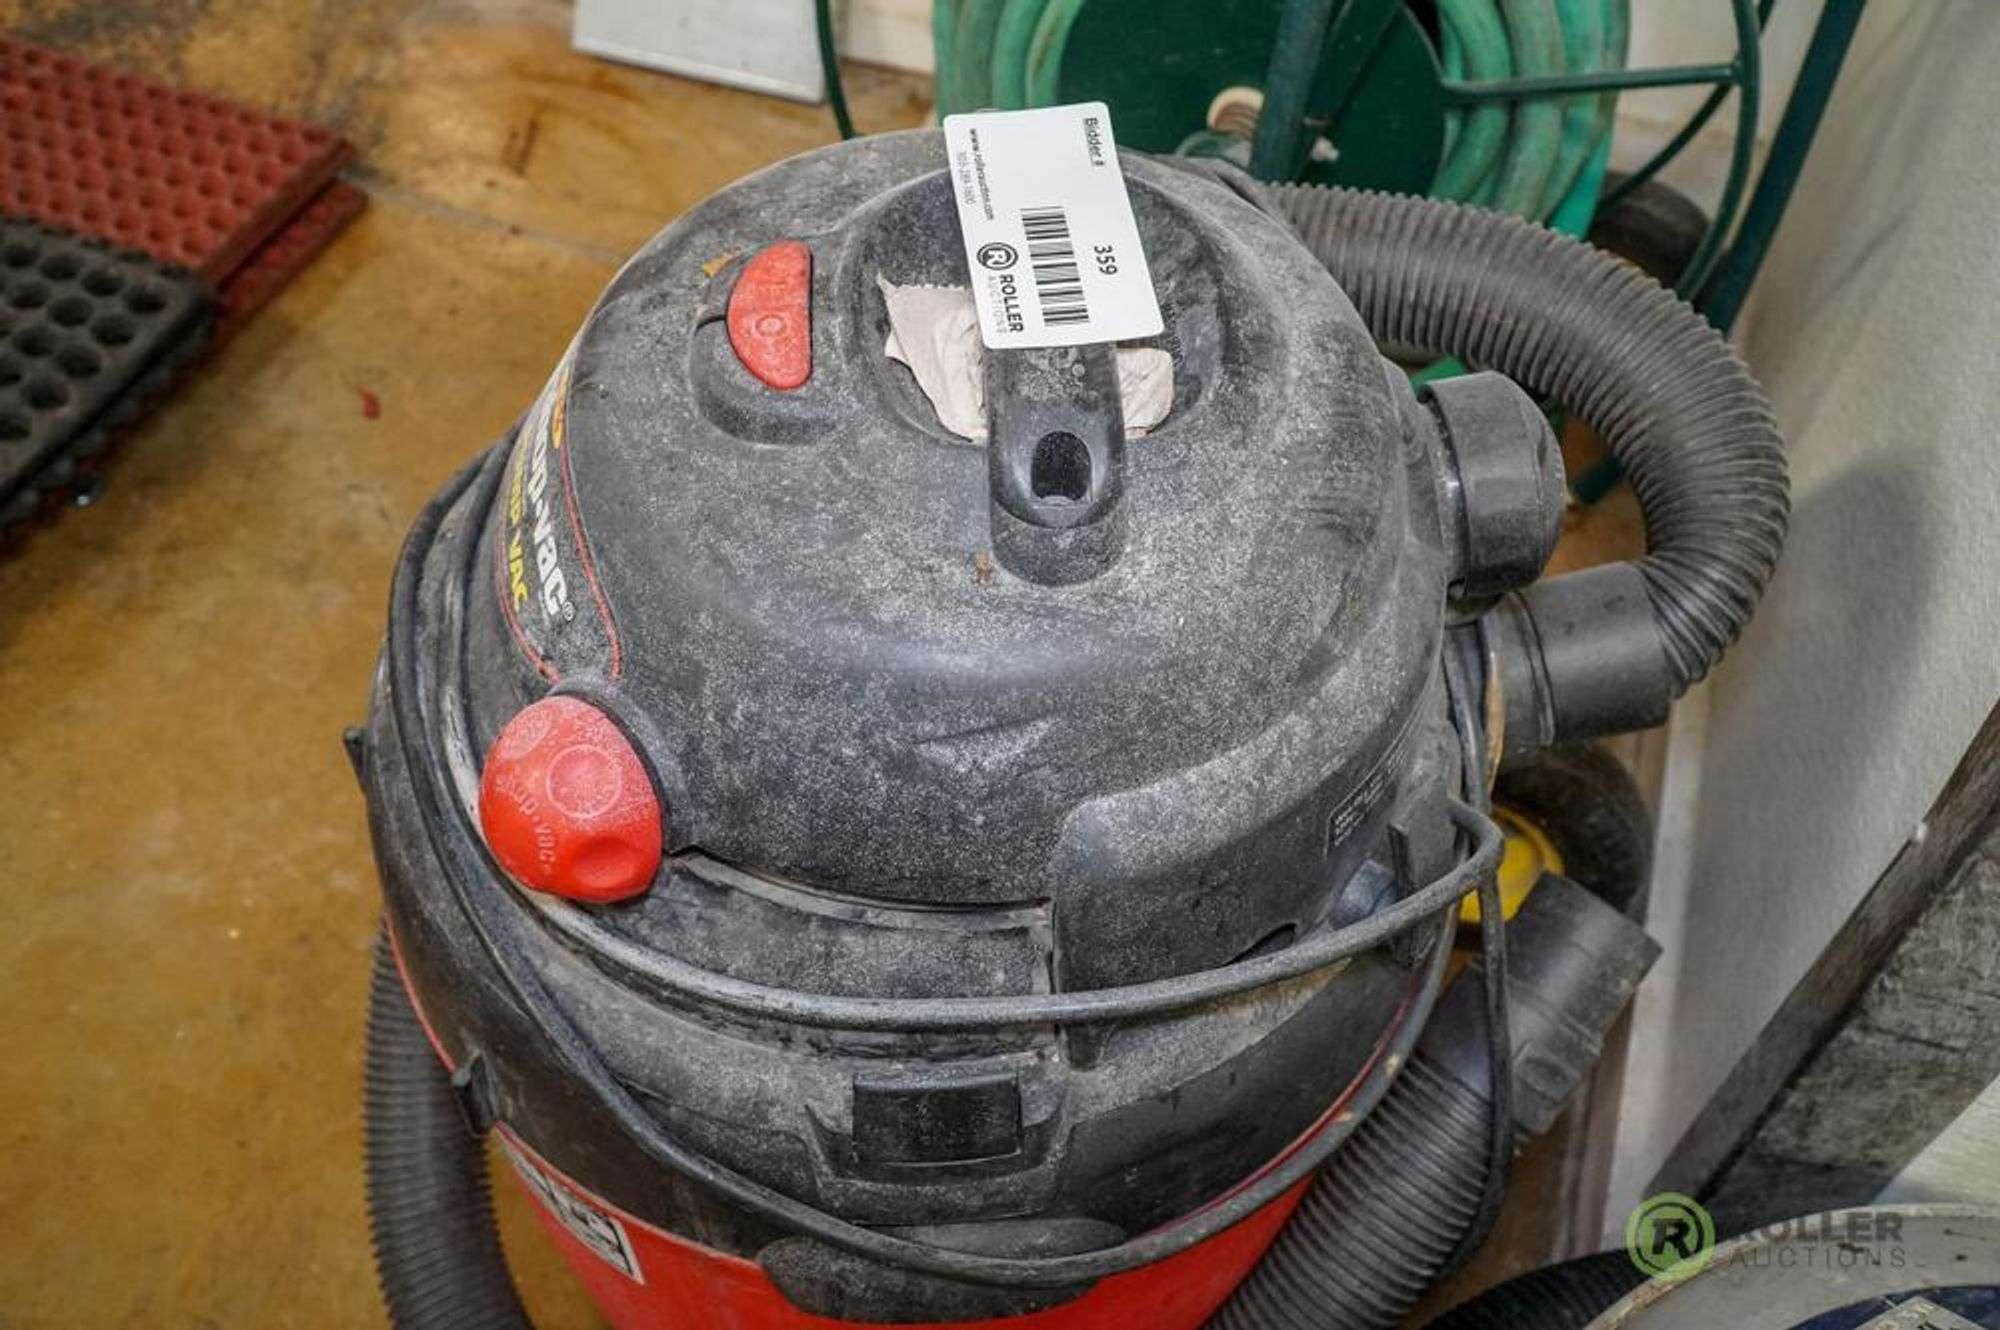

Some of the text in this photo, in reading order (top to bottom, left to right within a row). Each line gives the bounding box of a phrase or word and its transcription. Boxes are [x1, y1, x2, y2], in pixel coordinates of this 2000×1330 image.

[1084, 117, 1103, 159] Bidder
[1093, 244, 1119, 276] 359
[988, 275, 1007, 334] AUCTIONS
[999, 273, 1024, 333] ROLLER
[509, 527, 529, 616] VAC
